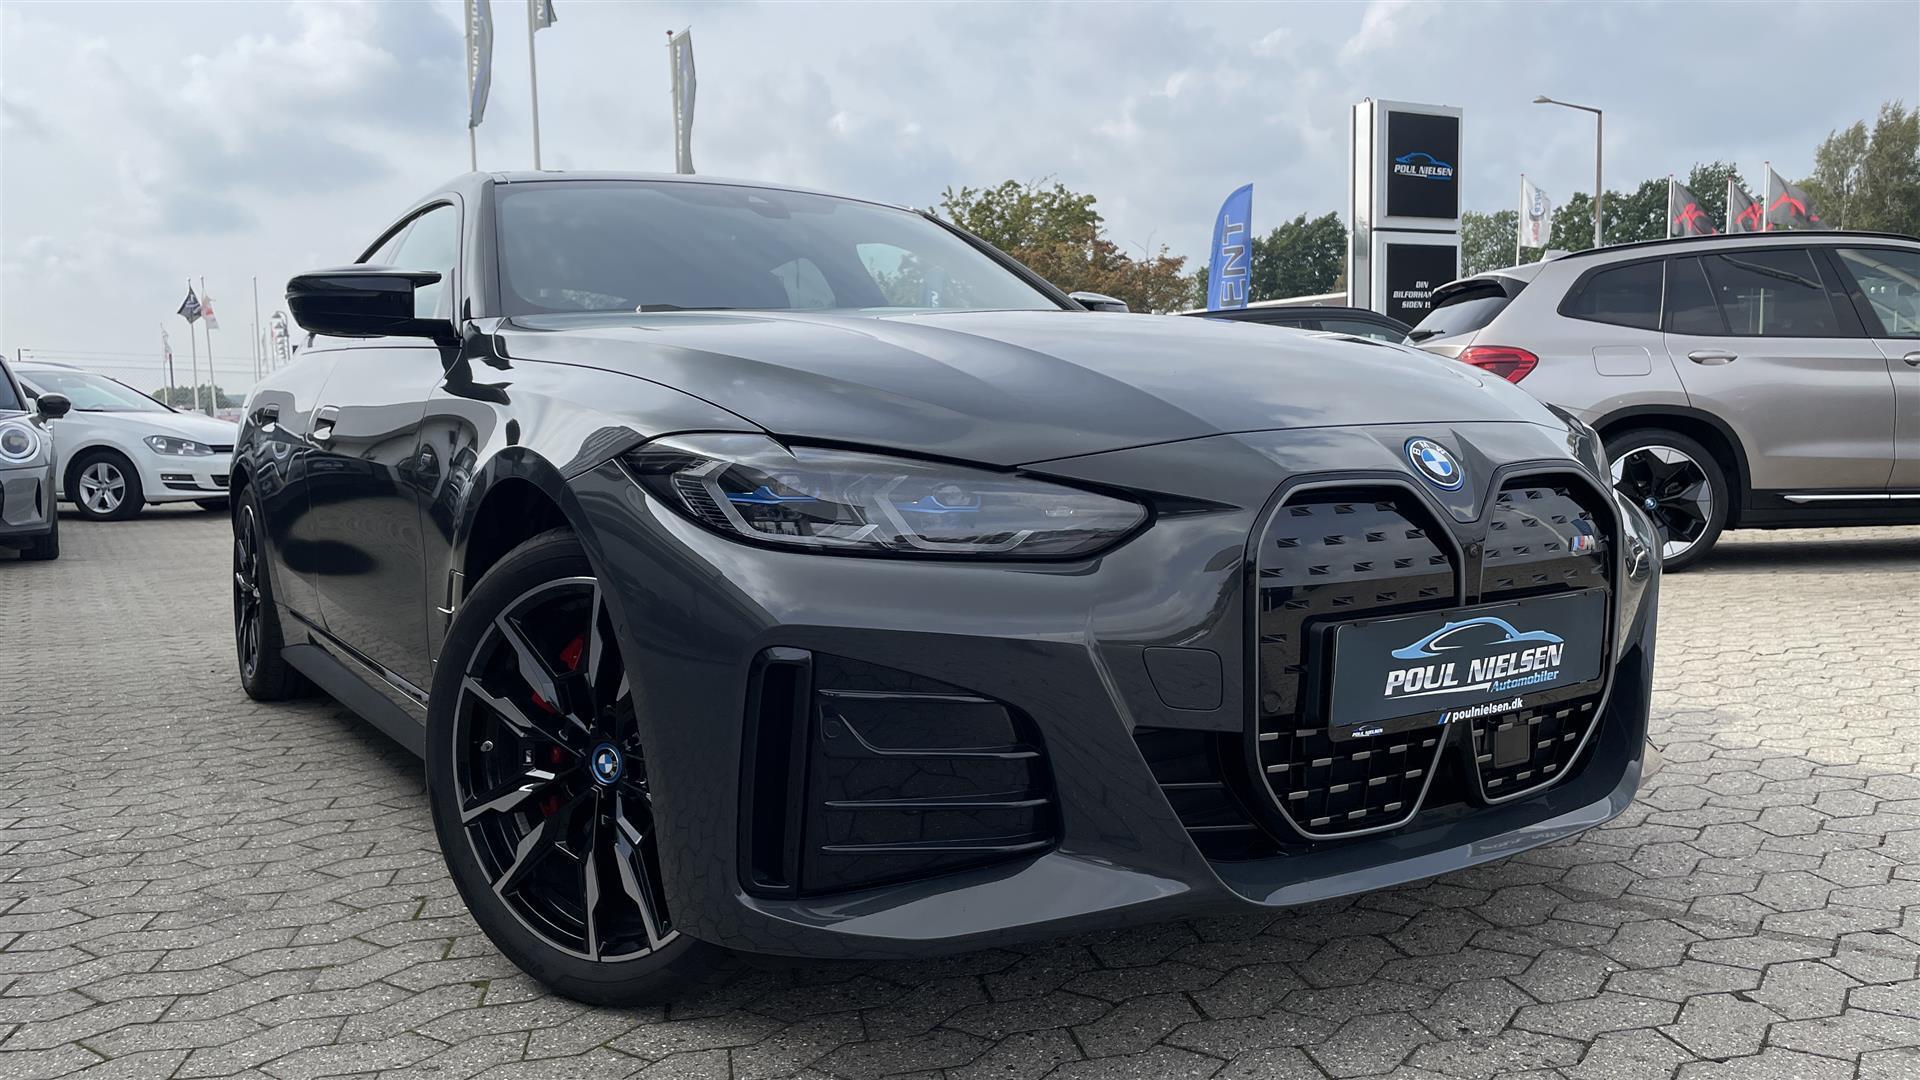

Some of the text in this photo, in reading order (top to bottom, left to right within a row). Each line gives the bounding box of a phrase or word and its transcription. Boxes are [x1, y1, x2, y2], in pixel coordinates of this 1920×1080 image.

[1394, 164, 1453, 177] POUL NIELSEN
[1415, 281, 1429, 289] DIN
[1401, 301, 1423, 309] SIDEN
[1384, 643, 1564, 696] POUL NIELSEN
[1490, 670, 1559, 693] Automobiler
[1452, 697, 1523, 723] poulnielsen.dk
